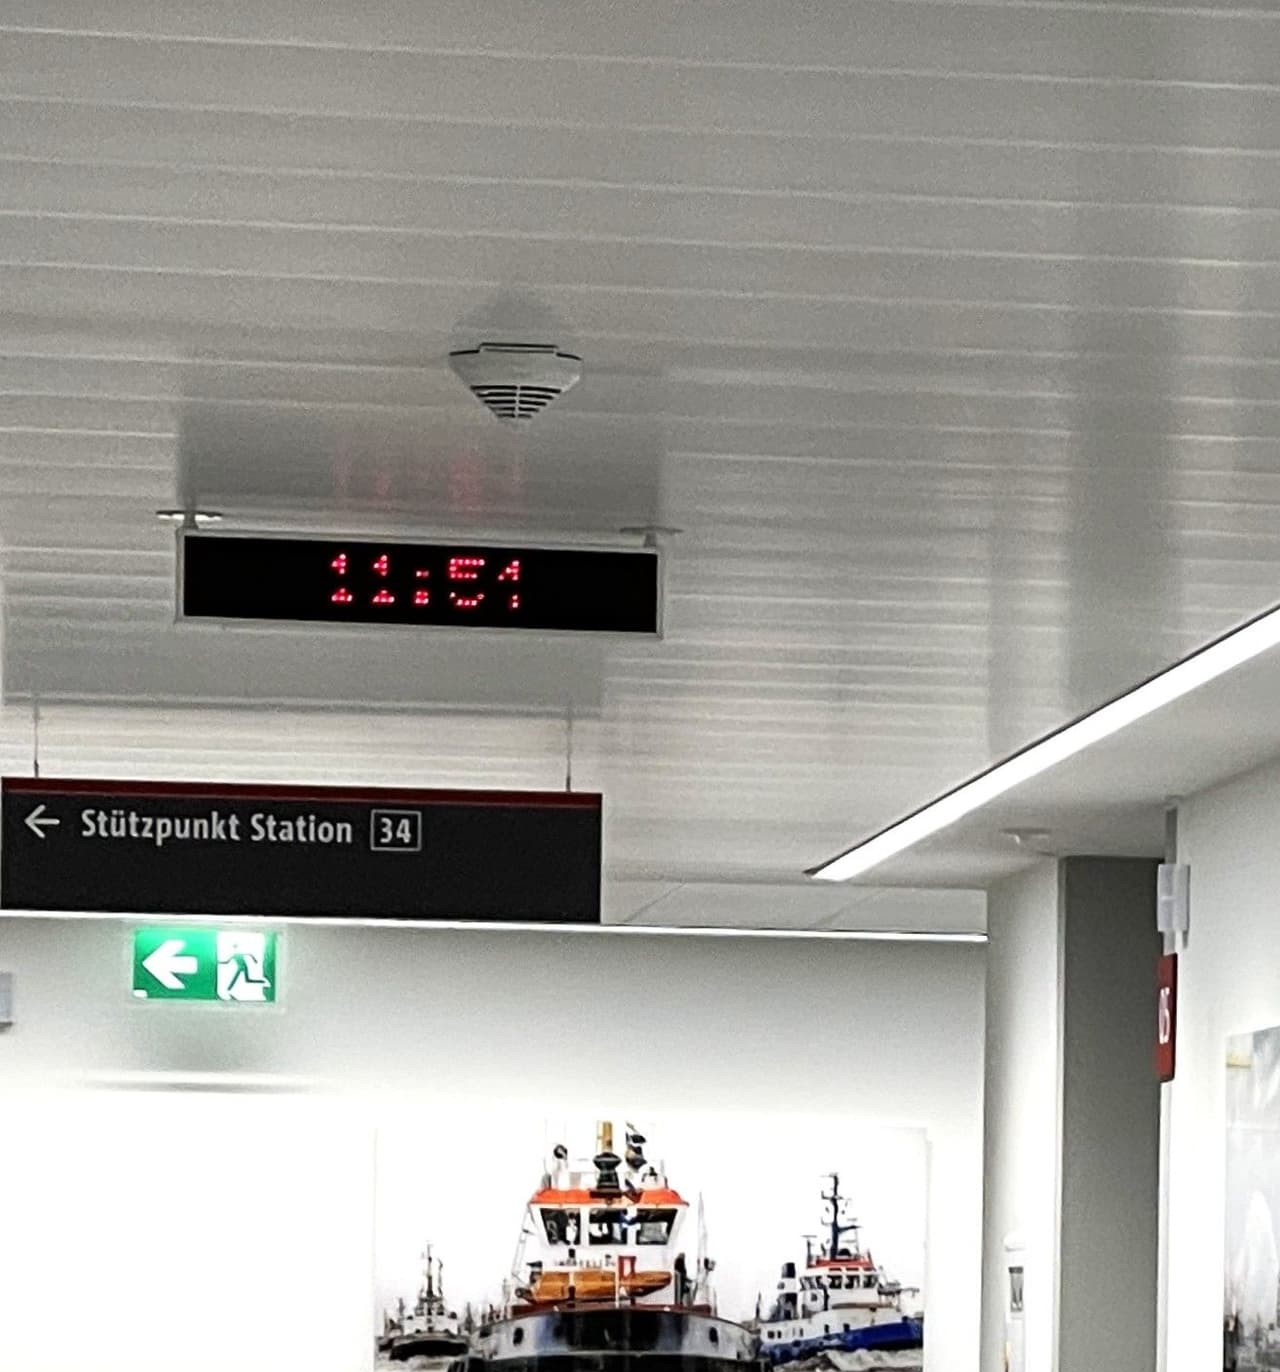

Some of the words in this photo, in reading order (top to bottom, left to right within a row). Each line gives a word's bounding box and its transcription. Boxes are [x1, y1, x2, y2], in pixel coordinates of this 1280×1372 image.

[331, 554, 520, 609] 11:51
[82, 810, 241, 847] Stützpunkt
[252, 813, 352, 843] Station
[379, 818, 412, 844] 34
